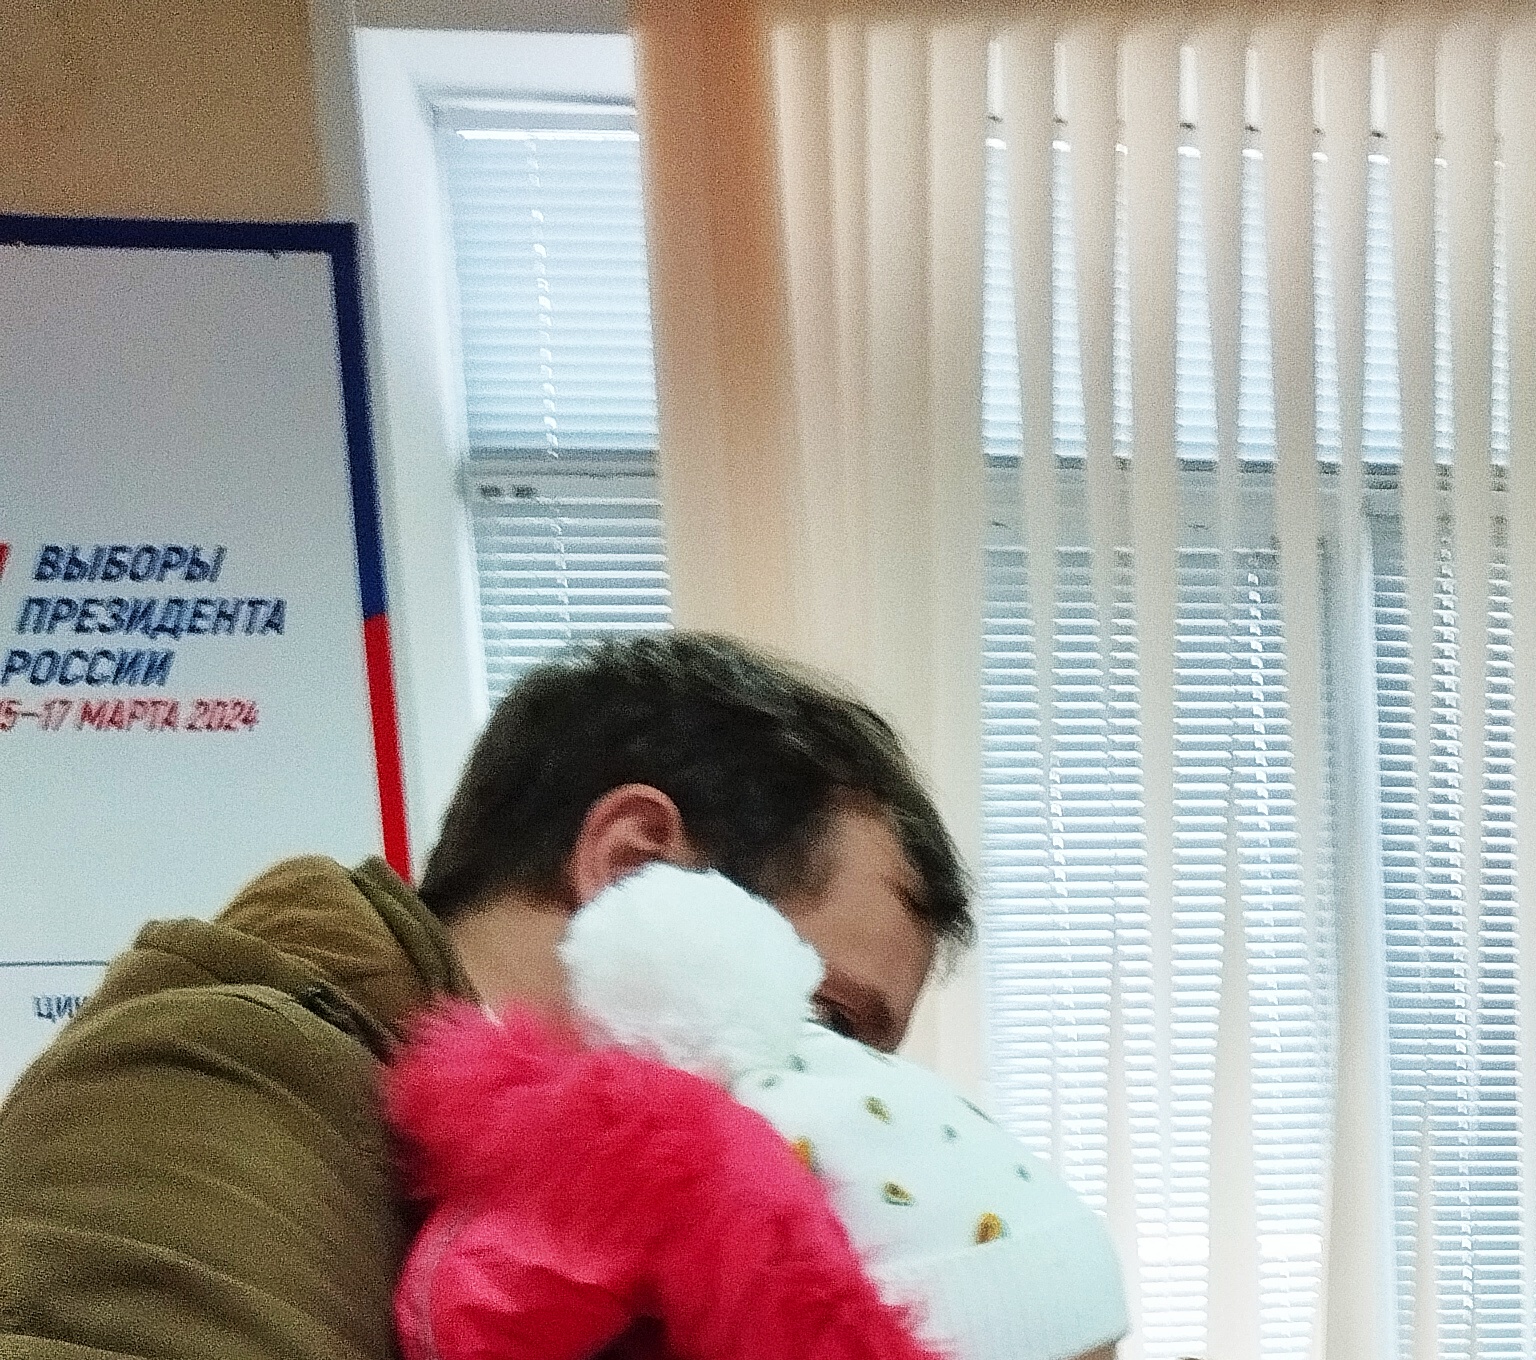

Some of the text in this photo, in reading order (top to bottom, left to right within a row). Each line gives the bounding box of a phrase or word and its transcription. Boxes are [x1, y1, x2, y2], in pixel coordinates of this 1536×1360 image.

[34, 544, 227, 582] ВЫБОРЫ
[16, 597, 287, 640] ПРЕЗИДЕНТА
[0, 649, 175, 686] РОССИИ
[74, 698, 179, 731] МАРТА
[186, 698, 259, 731] 2024
